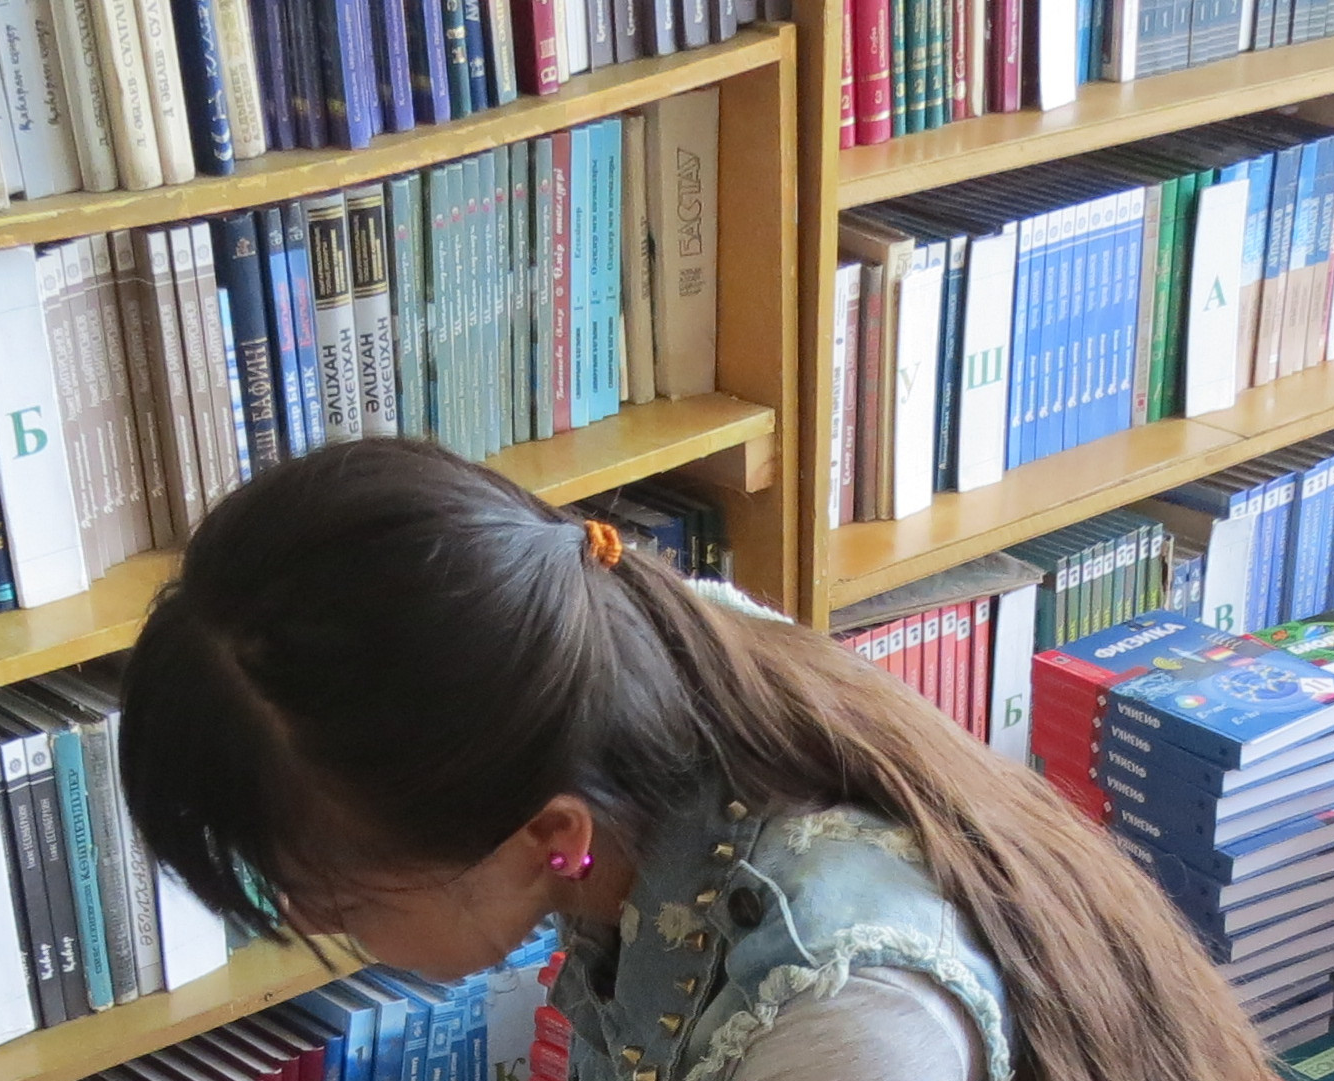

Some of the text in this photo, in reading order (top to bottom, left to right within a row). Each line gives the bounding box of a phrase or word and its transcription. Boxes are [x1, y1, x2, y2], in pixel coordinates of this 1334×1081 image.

[1204, 275, 1226, 312] А
[282, 370, 300, 403] БЕК
[301, 365, 319, 398] БЕК
[319, 343, 345, 425] ӘЛИХАН
[336, 327, 362, 434] БӨКЕЙХАН
[357, 331, 381, 413] ӘЛИХАН
[374, 316, 398, 421] БӨКЕЙХАН
[967, 344, 1005, 391] Ш
[7, 405, 49, 461] Б
[1215, 602, 1233, 634] В
[1095, 623, 1187, 659] ФИЗИКА
[1004, 695, 1023, 729] Б
